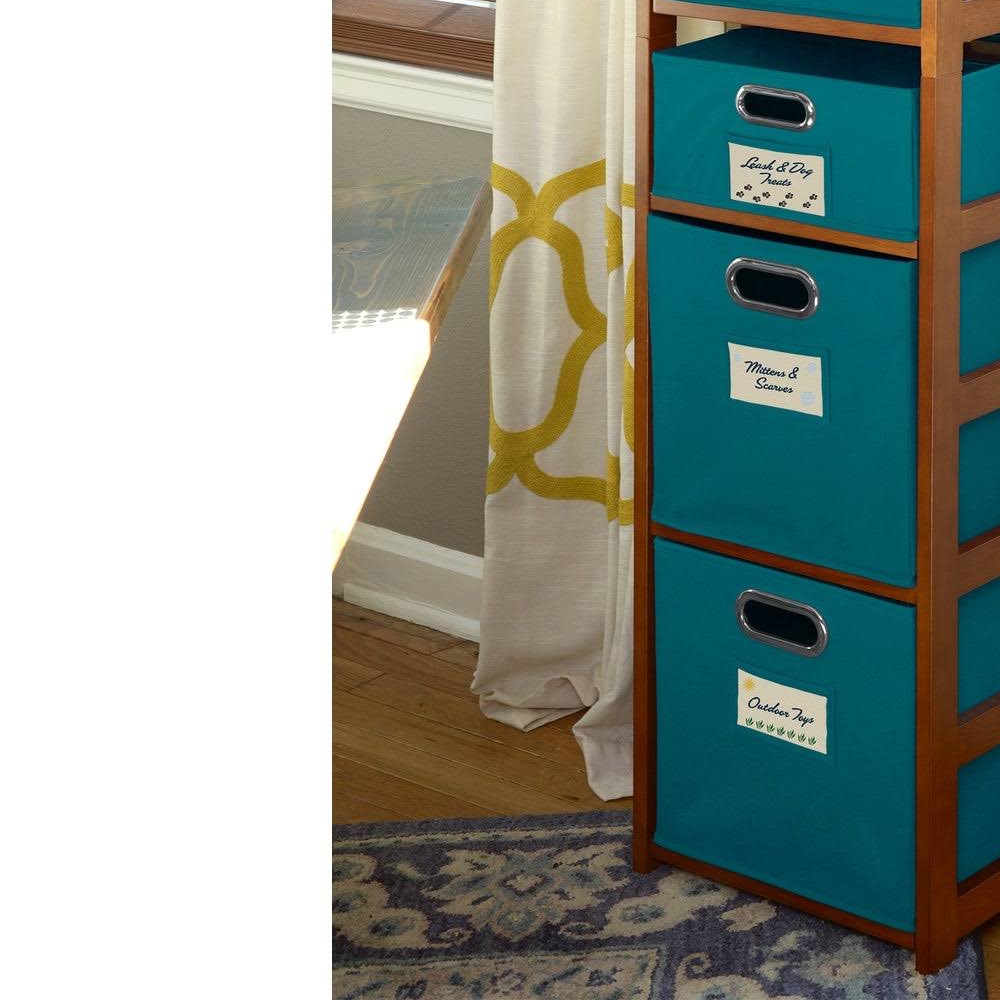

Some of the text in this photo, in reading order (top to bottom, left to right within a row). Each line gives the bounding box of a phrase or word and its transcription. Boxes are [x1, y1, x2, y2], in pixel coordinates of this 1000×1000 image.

[740, 156, 814, 179] Leash & Dog
[759, 172, 792, 187] Treats
[744, 361, 799, 379] Mittens &
[755, 377, 794, 393] Scarves
[747, 696, 815, 727] Outdoor Toys
